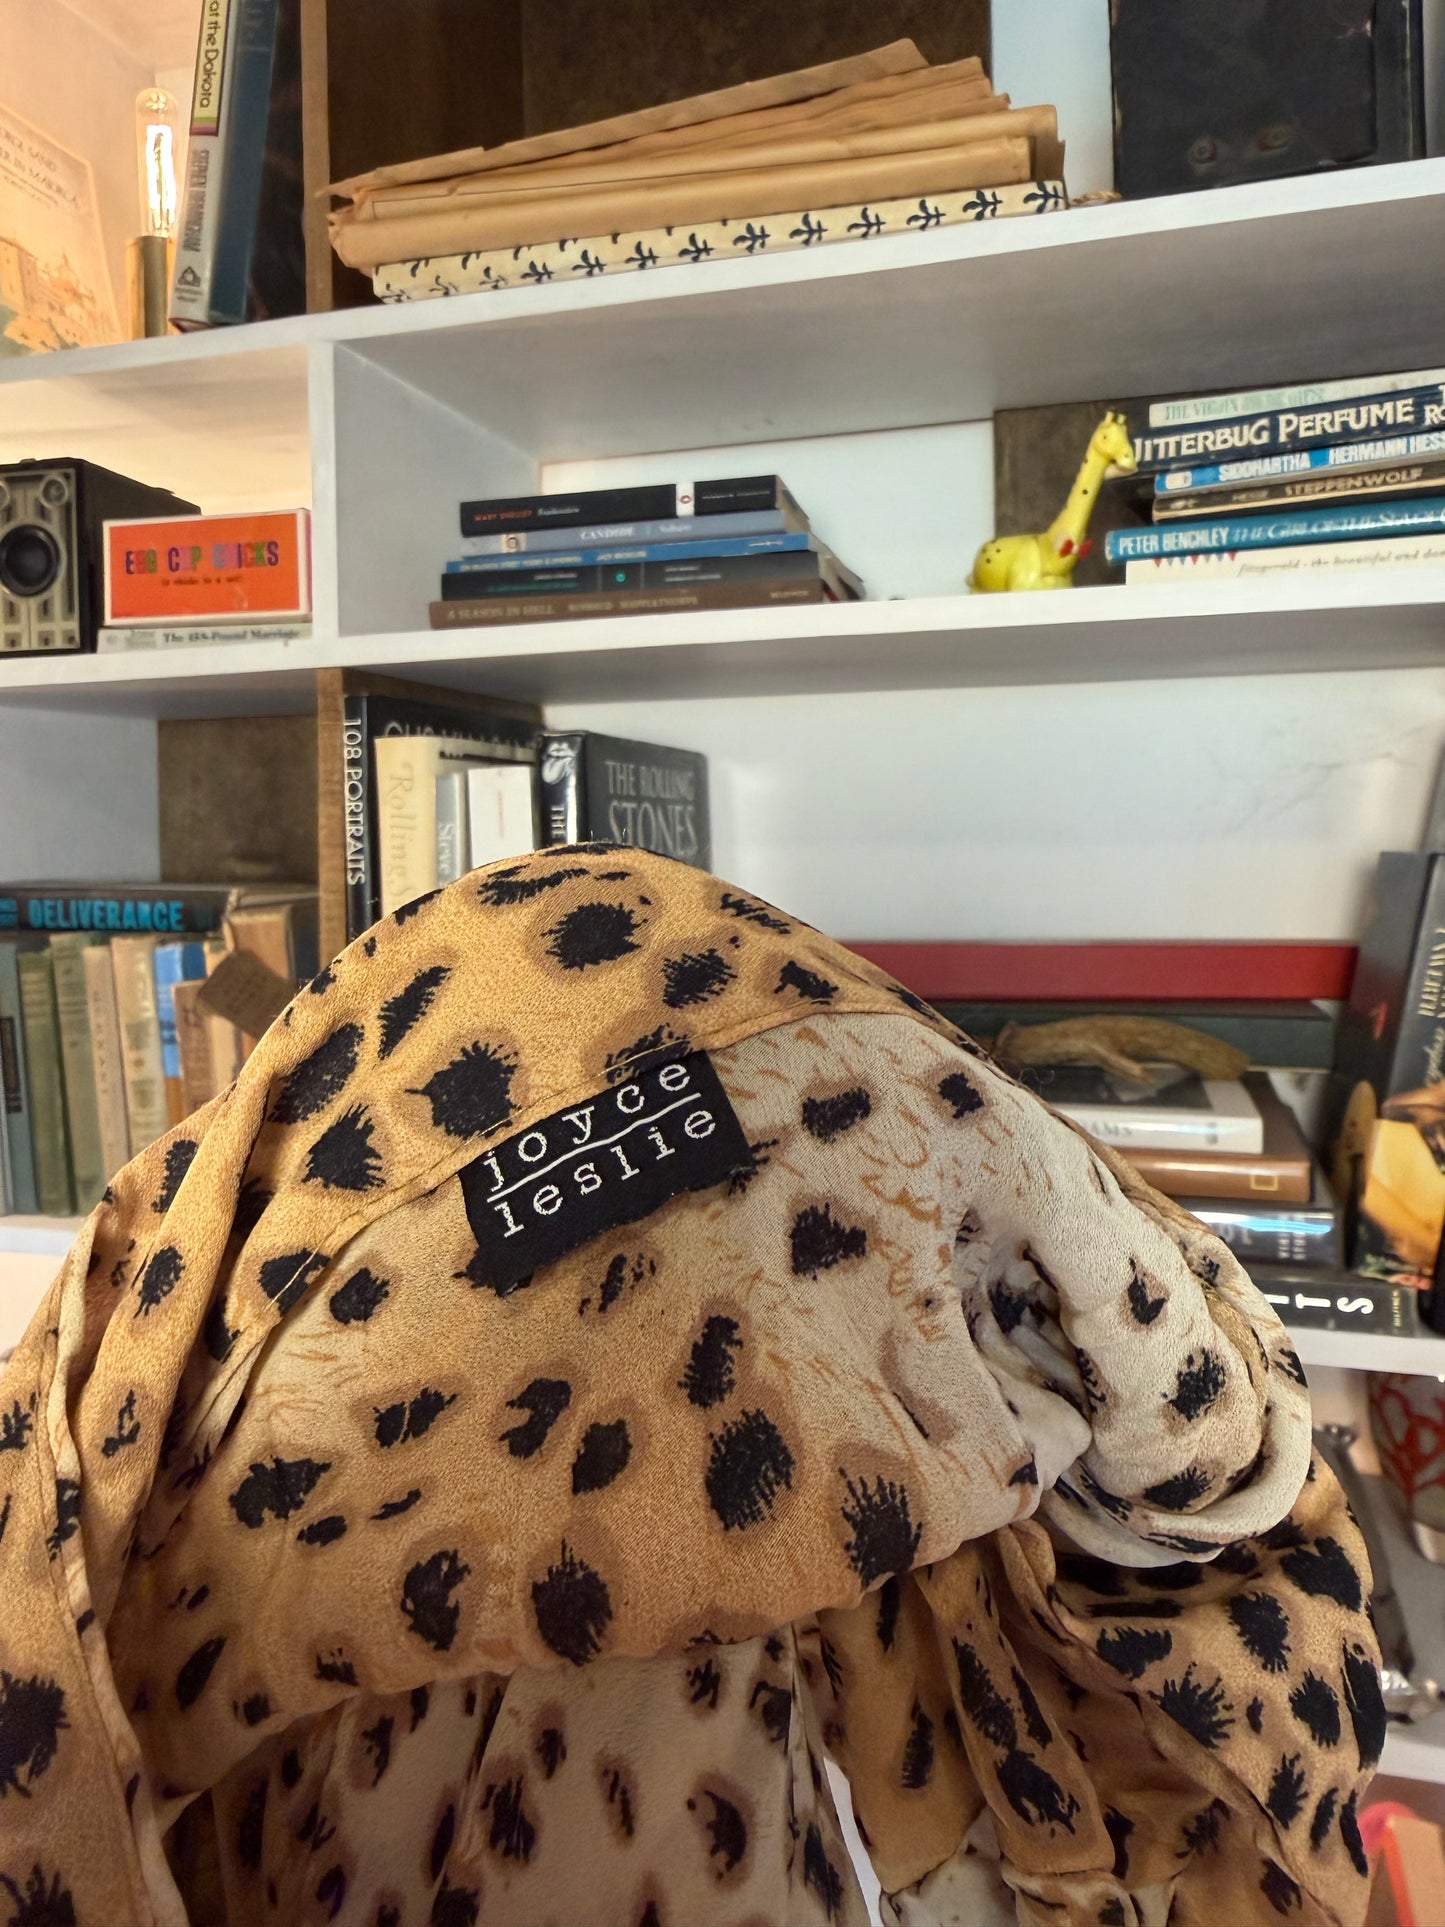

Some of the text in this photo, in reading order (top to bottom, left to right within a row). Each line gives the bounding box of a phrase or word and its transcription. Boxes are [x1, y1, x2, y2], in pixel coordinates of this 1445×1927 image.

[206, 20, 221, 46] the
[200, 48, 220, 108] Dakota
[1133, 418, 1270, 464] JITTERBUG
[1279, 398, 1415, 443] PERFUME
[1219, 451, 1311, 481] SIDDHARTHA
[1329, 437, 1407, 465] HERMANN
[1284, 466, 1424, 497] STEPPENWOLF
[168, 545, 202, 573] CUP
[212, 540, 279, 570] CHICKS
[1119, 532, 1159, 555] PETER
[1163, 527, 1230, 552] BENCHLEY
[163, 632, 185, 643] The
[343, 718, 366, 886] 108 PORTRAITS
[605, 760, 695, 801] THE ROLLING
[437, 822, 456, 875] Steve
[609, 799, 699, 856] STONES
[28, 898, 185, 932] DELIVERANCE
[483, 1063, 691, 1192] joyce
[494, 1110, 716, 1239] leslie
